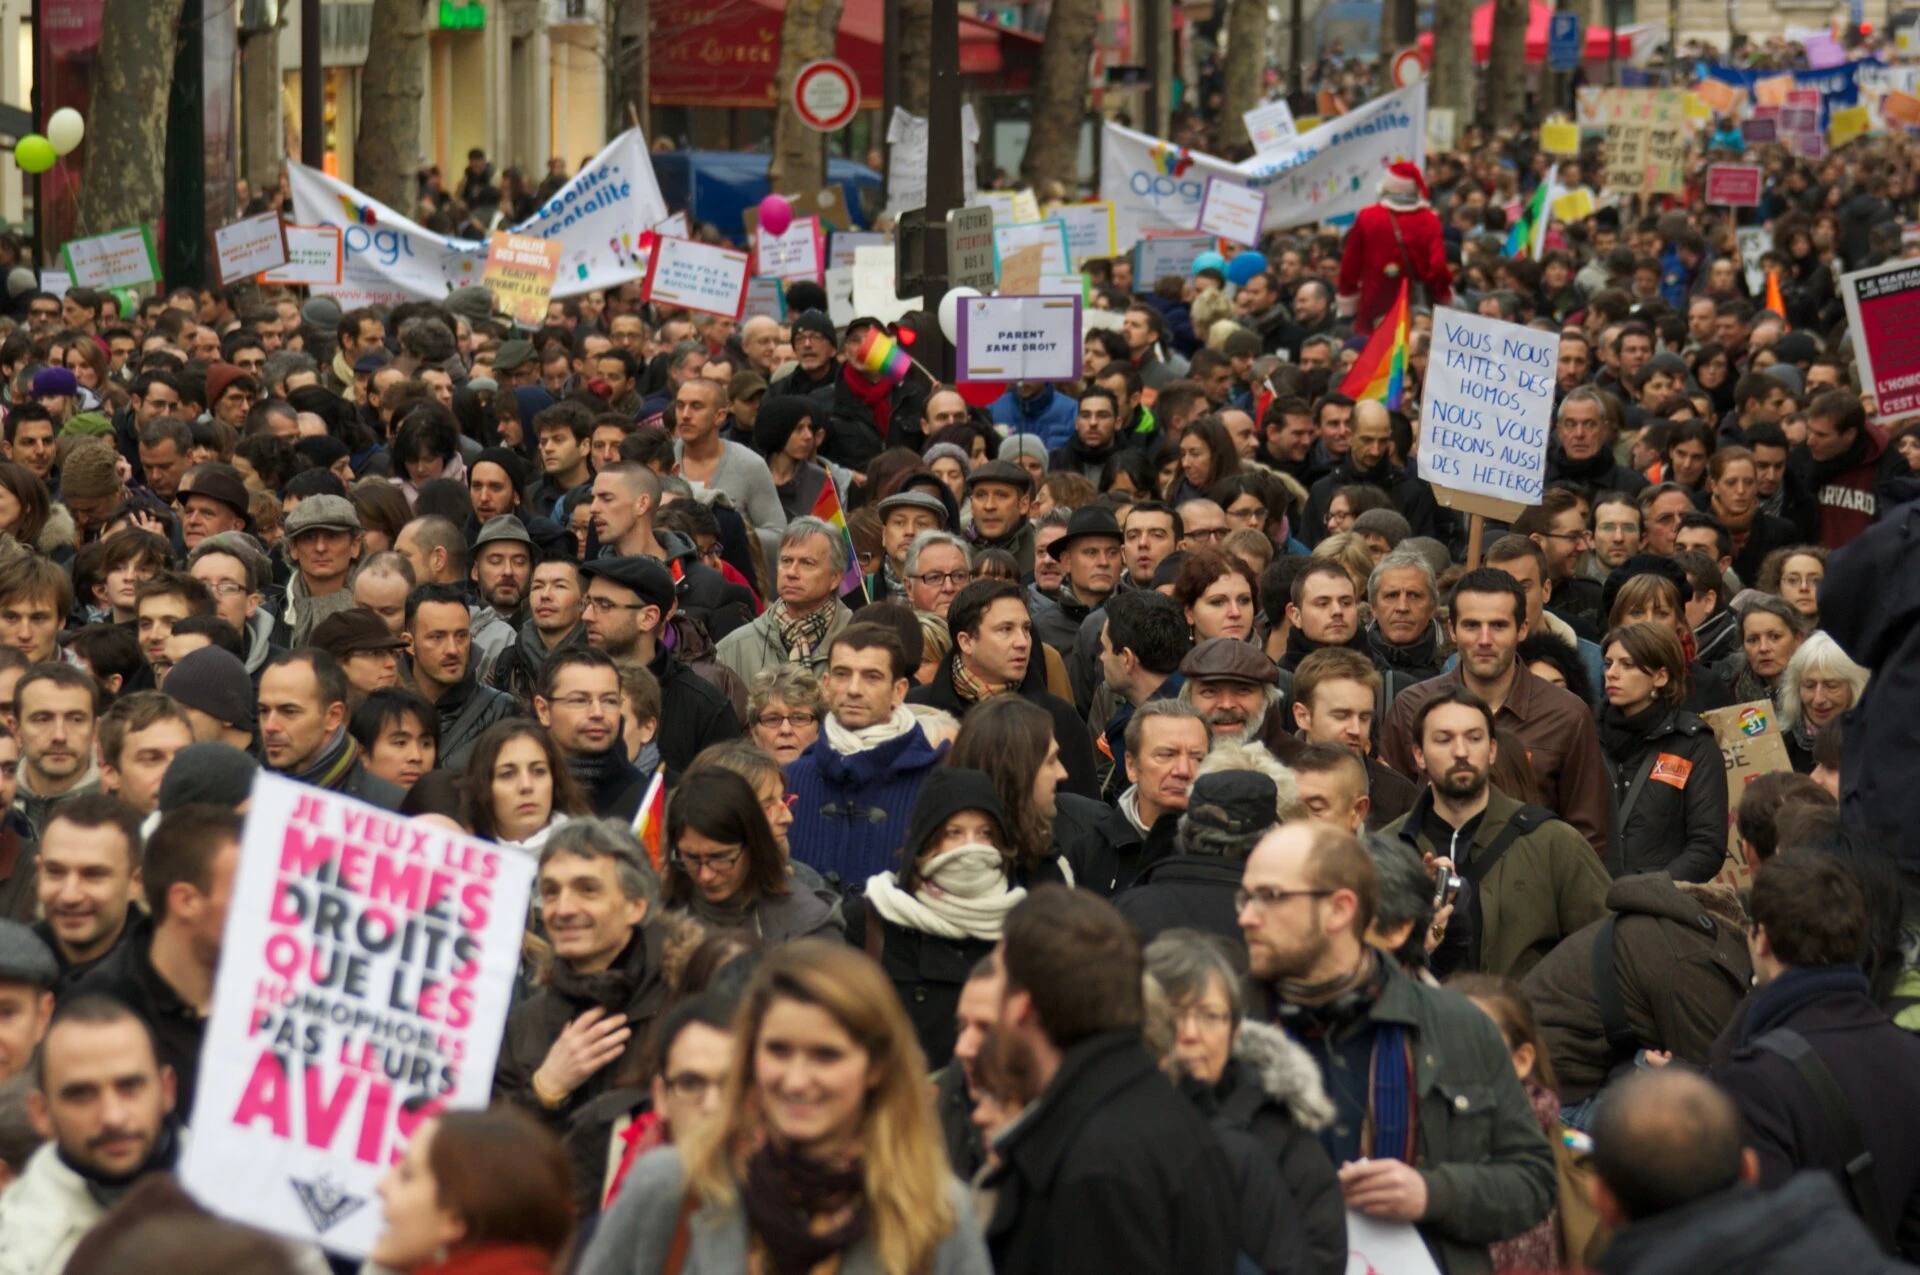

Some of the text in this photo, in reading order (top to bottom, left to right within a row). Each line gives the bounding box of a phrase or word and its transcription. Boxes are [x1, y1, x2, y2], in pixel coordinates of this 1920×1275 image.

[1330, 112, 1410, 146] entalité
[1130, 171, 1201, 207] apg
[343, 224, 414, 265] pgl
[956, 232, 992, 251] ATTENTION
[965, 254, 977, 270] BUS
[1859, 269, 1920, 291] LE MARIA
[986, 342, 1057, 353] SANS DROIT
[998, 330, 1045, 340] PARENT
[1445, 322, 1552, 368] VOUS NOUS
[1446, 349, 1549, 398] FAITES DES
[1459, 377, 1527, 417] HOMOS,
[1883, 395, 1913, 413] C'EST
[1432, 399, 1544, 448] NOUS VOUS
[1432, 426, 1541, 471] FERONS AUSSI
[1432, 453, 1460, 476] DES
[1818, 485, 1875, 515] ARVARD
[291, 792, 499, 880] JE VEUX LES
[279, 827, 493, 931] MEMES
[269, 880, 483, 982] DROITS
[264, 932, 475, 1031] QUE LES
[256, 978, 467, 1060] HOMOPHOBES
[247, 1008, 459, 1097] PAS LEURS
